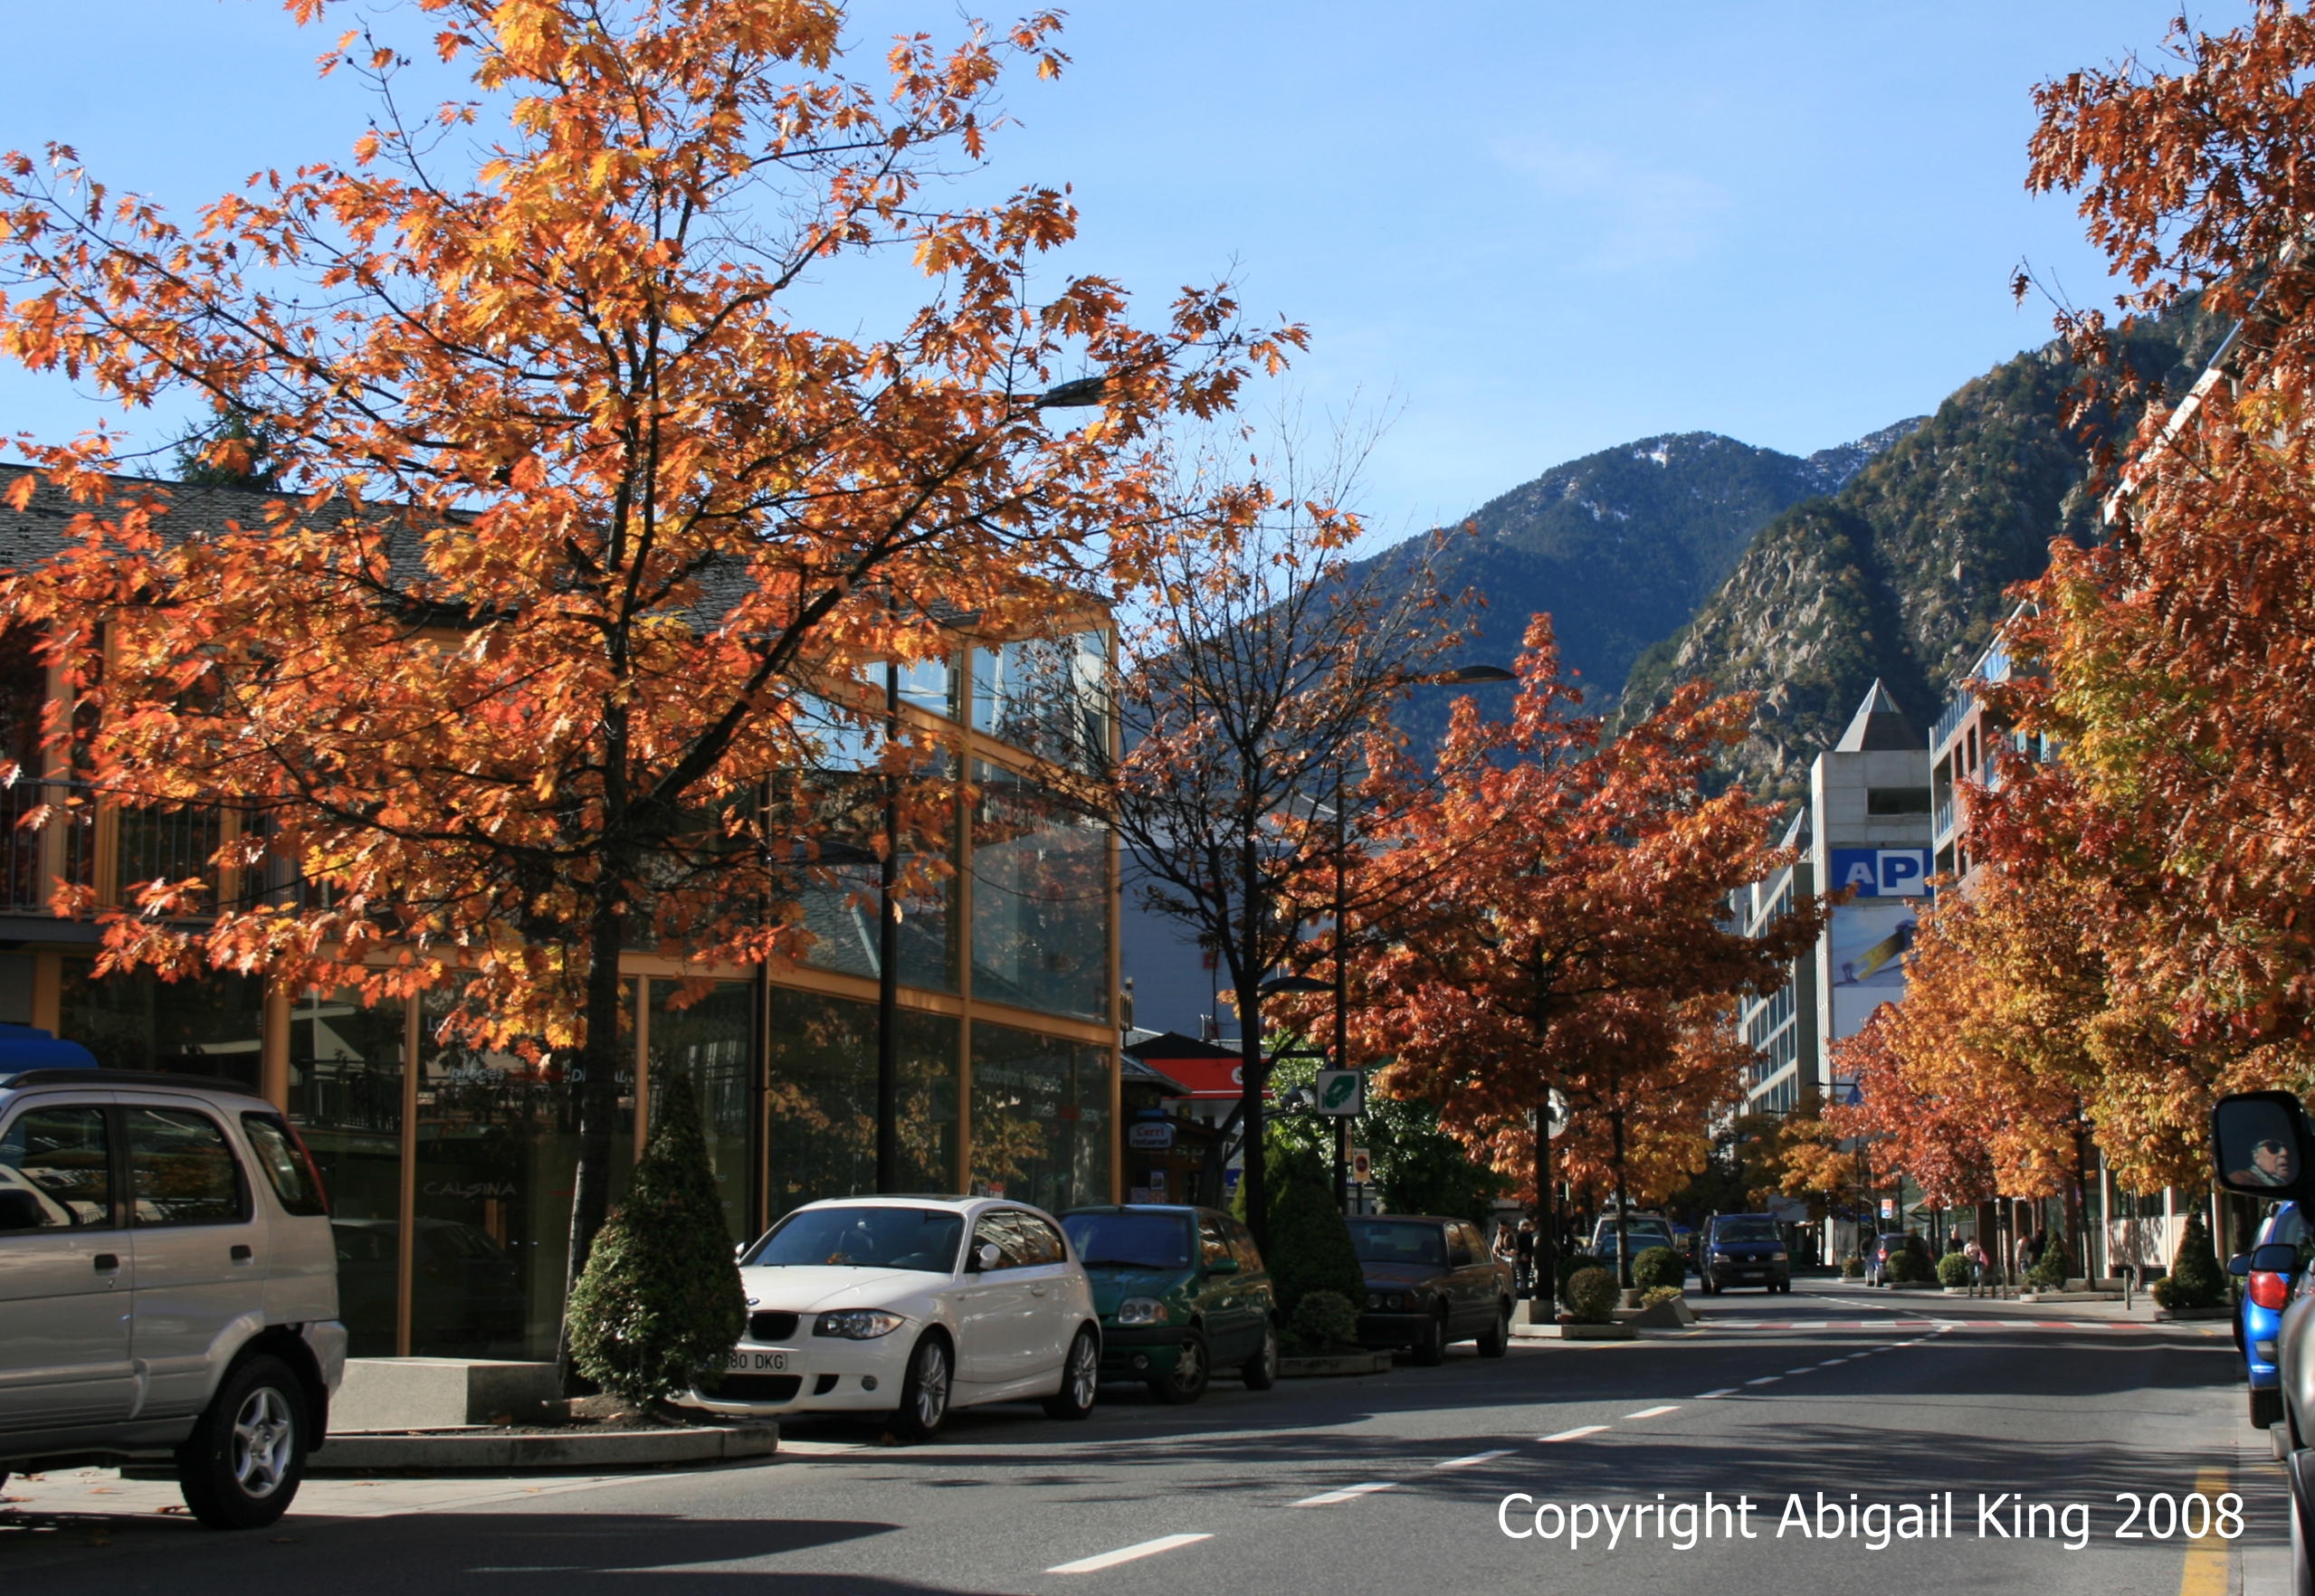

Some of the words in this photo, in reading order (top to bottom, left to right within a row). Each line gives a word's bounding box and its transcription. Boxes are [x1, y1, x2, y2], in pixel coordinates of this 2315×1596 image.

[1845, 858, 1934, 888] AP
[1132, 1137, 1169, 1146] restaurant
[423, 1182, 517, 1199] CALSINA
[755, 1354, 784, 1370] DKG
